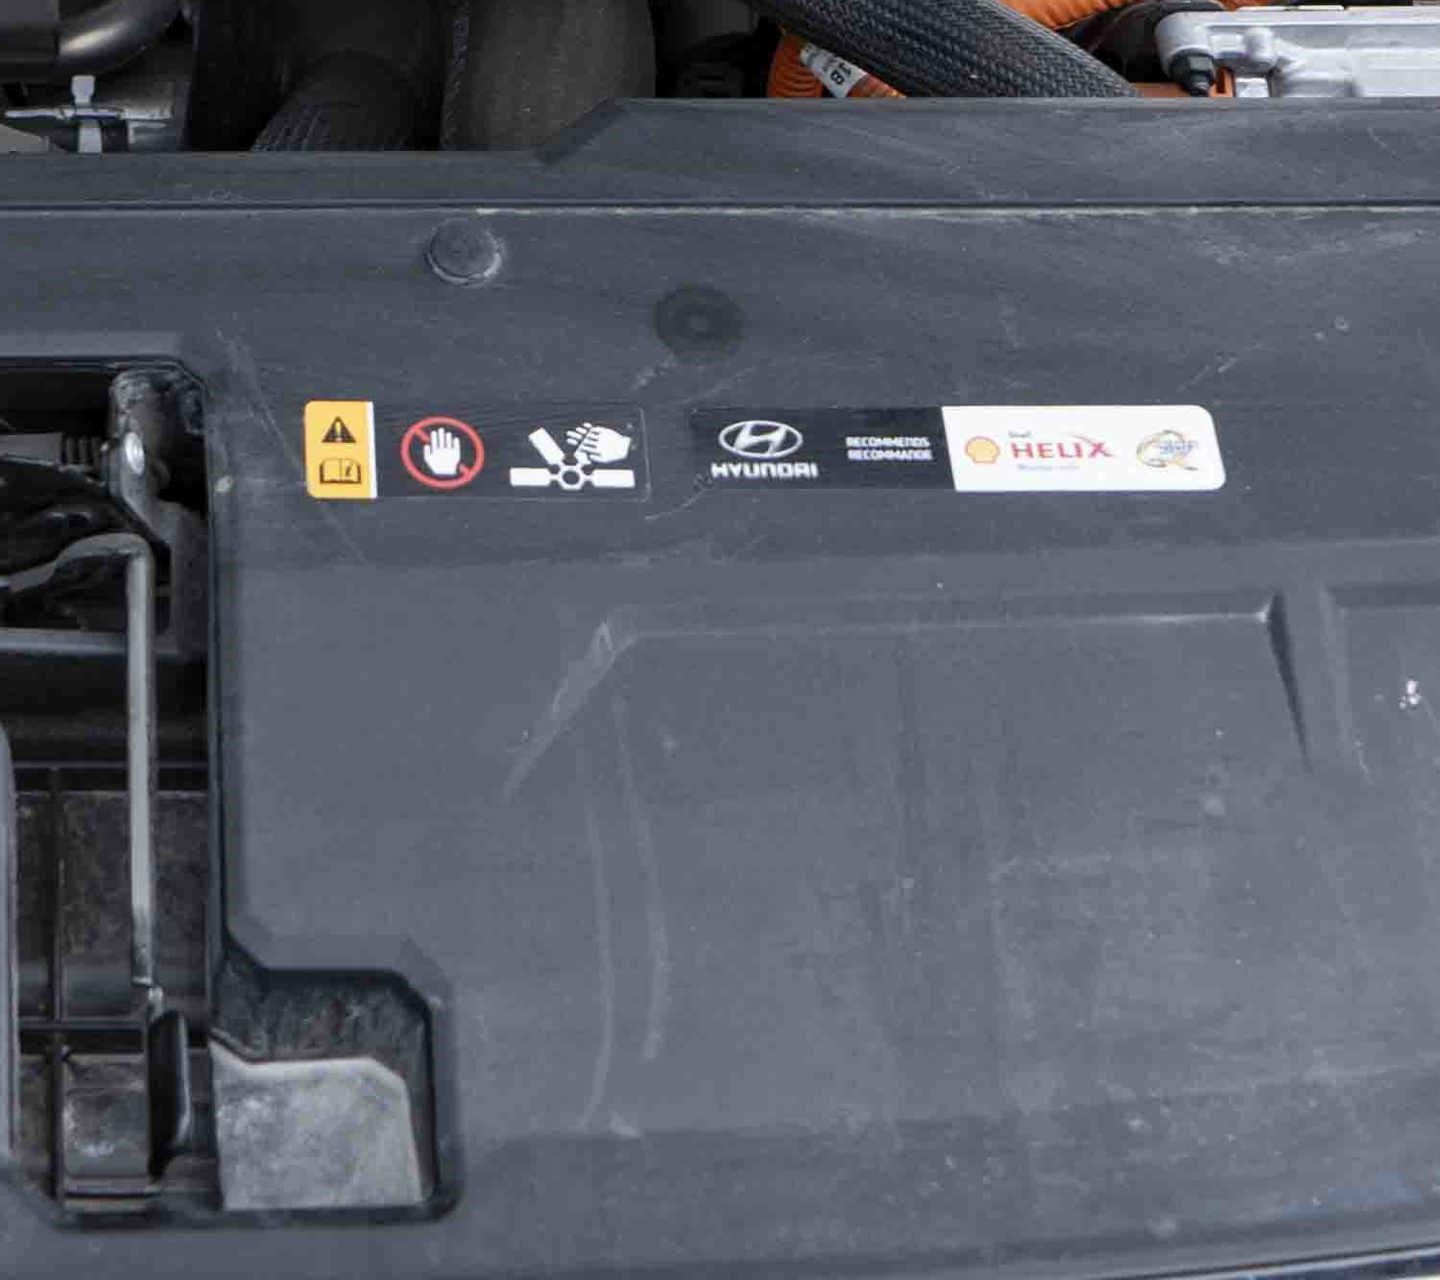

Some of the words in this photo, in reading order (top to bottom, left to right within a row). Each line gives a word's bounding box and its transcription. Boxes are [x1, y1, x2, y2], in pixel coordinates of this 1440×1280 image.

[846, 436, 931, 448] RECOMMENDS
[1010, 441, 1115, 459] HELIX
[711, 462, 818, 478] HYUNDAI
